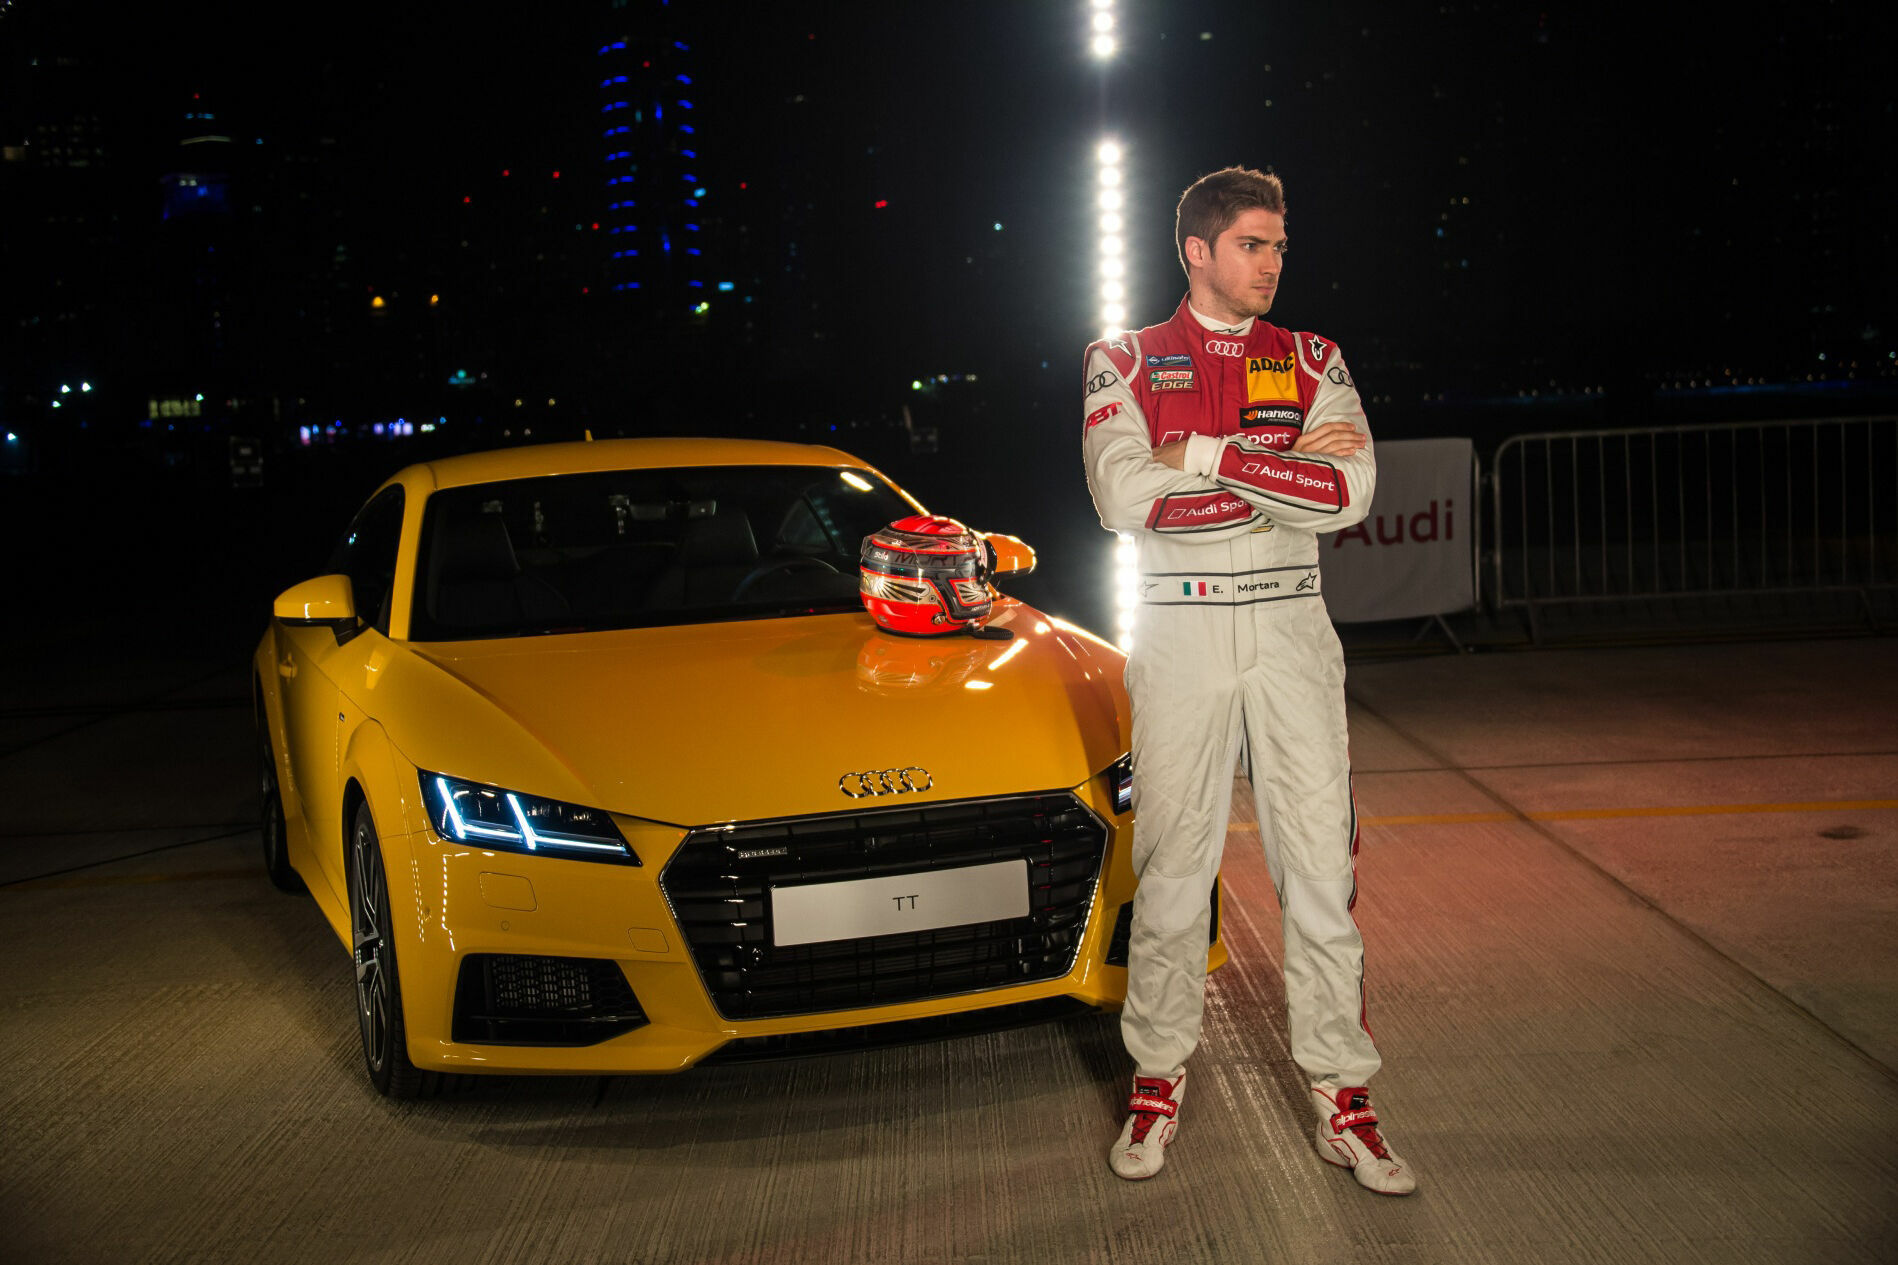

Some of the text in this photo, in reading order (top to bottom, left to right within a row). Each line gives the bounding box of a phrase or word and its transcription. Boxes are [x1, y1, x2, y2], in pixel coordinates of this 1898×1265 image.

[1249, 356, 1294, 374] ADAC
[1160, 372, 1191, 380] Castrol
[1151, 381, 1194, 391] EDGE
[1236, 431, 1291, 445] port
[1260, 465, 1336, 492] Audi Sport
[1186, 499, 1248, 517] Audi Spo
[1333, 499, 1454, 549] Audi
[1212, 580, 1280, 594] E. Mortara
[892, 895, 919, 911] TT
